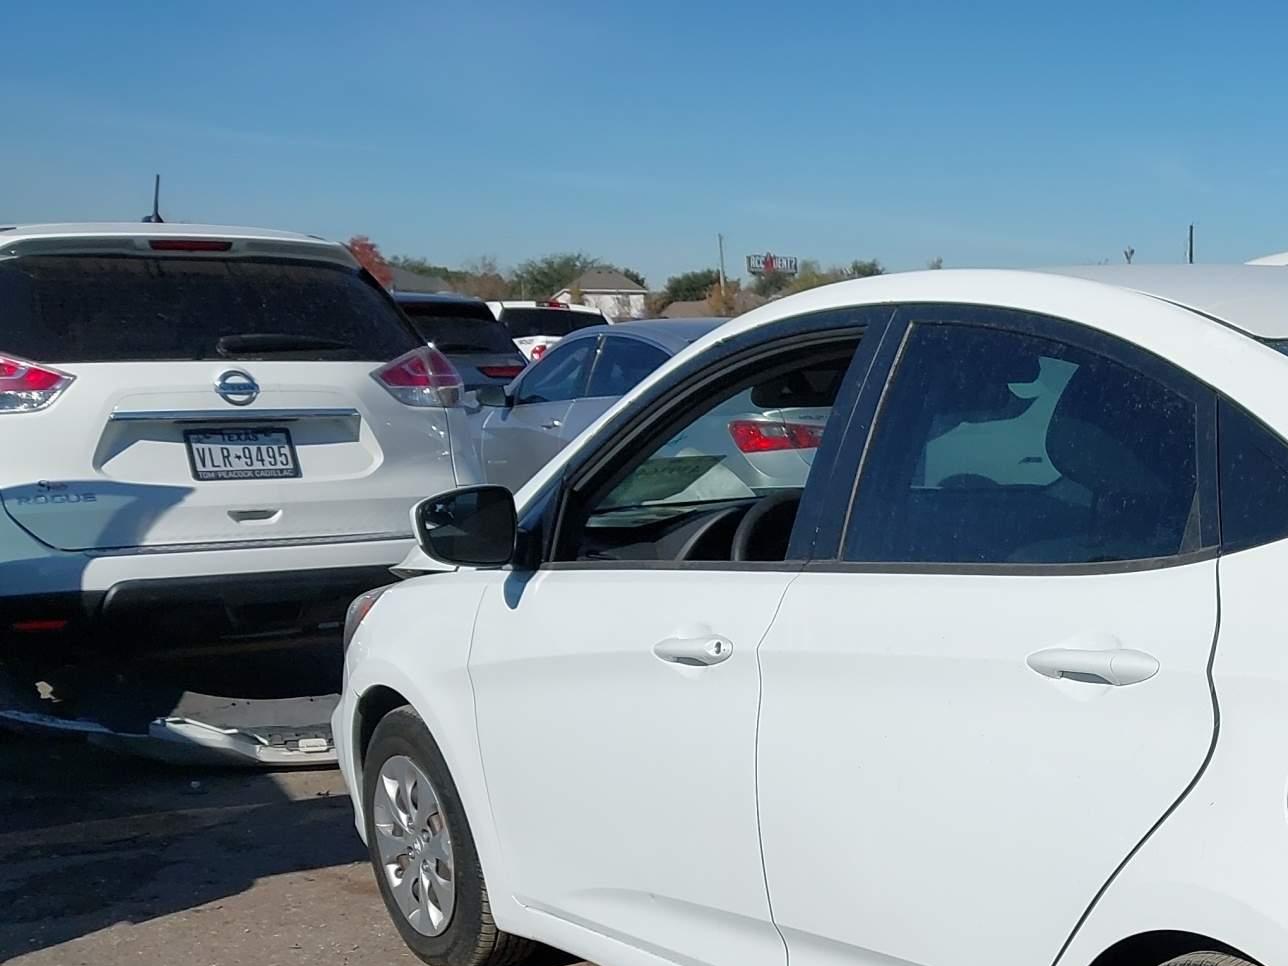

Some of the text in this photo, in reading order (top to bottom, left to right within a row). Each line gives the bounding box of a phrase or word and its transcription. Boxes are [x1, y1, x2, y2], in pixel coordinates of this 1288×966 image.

[221, 431, 259, 442] TEXAS
[255, 469, 295, 478] CADILLAC
[16, 493, 97, 505] ROGUE
